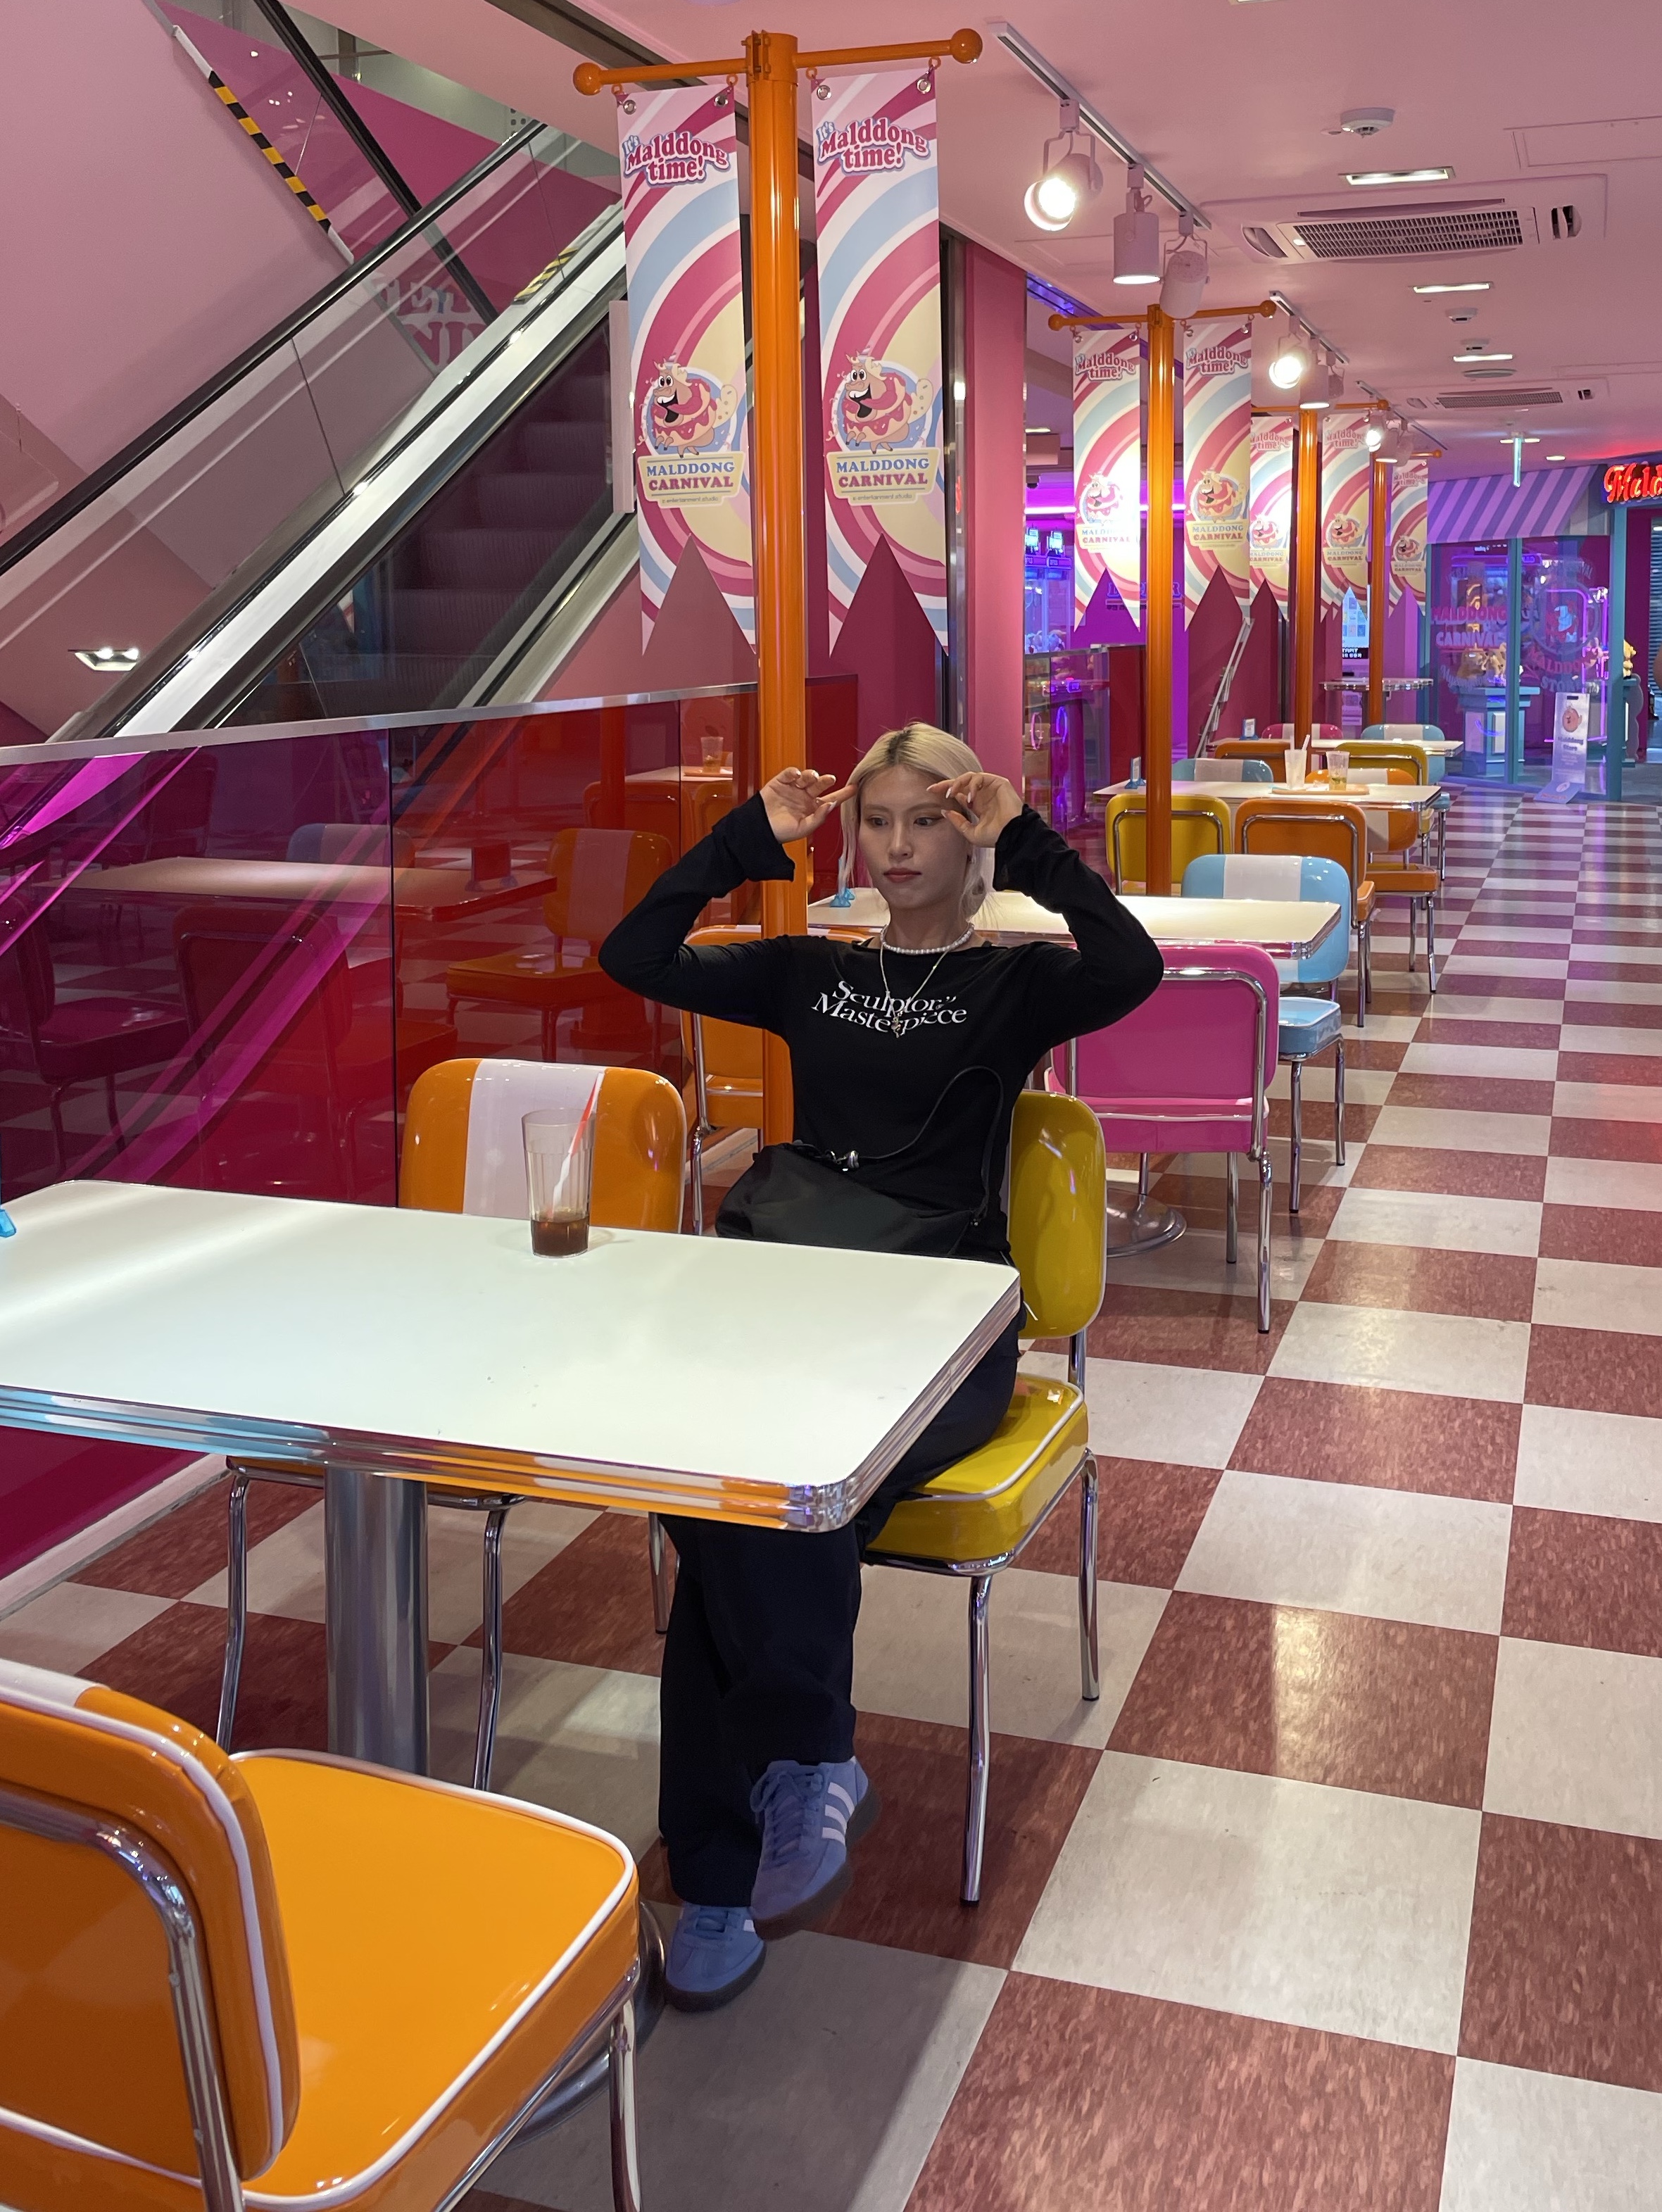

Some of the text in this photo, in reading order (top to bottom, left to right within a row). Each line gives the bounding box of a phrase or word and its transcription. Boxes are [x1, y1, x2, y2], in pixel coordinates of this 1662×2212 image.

[817, 122, 835, 141] It's
[821, 118, 927, 158] Malddong
[622, 135, 640, 154] It's
[627, 132, 727, 171] Malddong
[843, 142, 903, 168] time!
[648, 155, 703, 181] time!
[1077, 353, 1135, 372] Malddong
[1188, 346, 1247, 366] Malddong
[1201, 359, 1233, 372] time!
[1090, 365, 1121, 378] time!
[647, 462, 735, 477] MALDDONG
[836, 458, 929, 473] MALDDONG
[648, 476, 734, 491] CARNIVAL
[838, 472, 928, 488] CARNIVAL
[1431, 606, 1506, 621] MALDDONG
[1435, 631, 1506, 646] CARNIVAL
[810, 992, 967, 1036] Mastepiece
